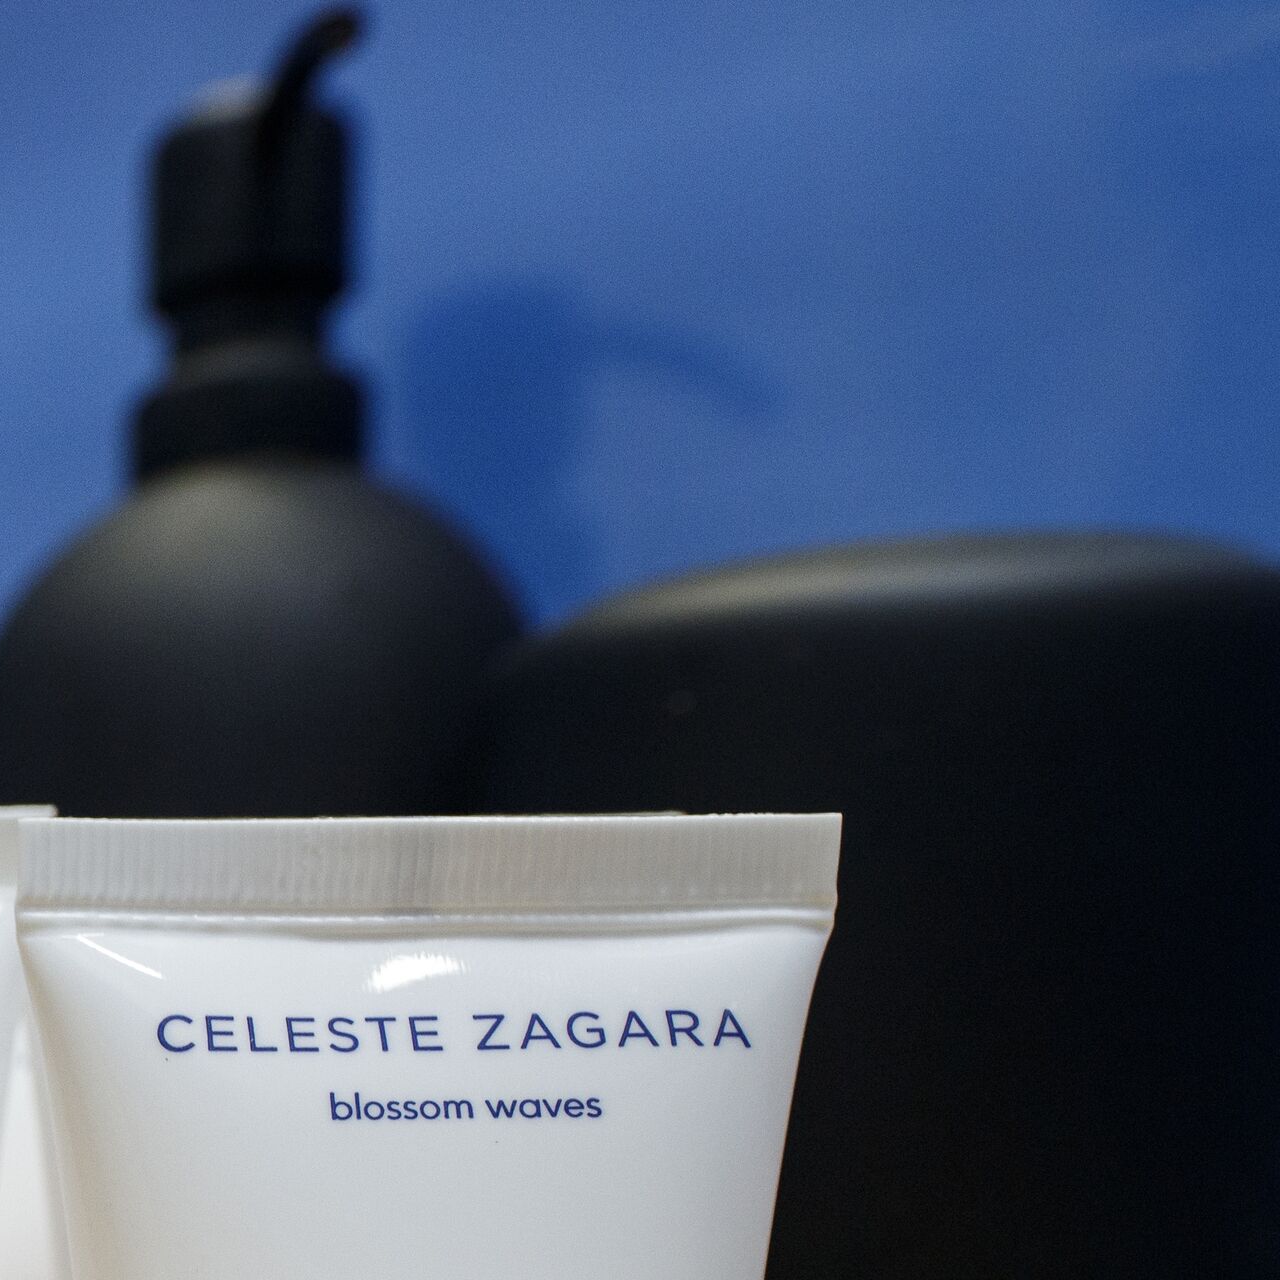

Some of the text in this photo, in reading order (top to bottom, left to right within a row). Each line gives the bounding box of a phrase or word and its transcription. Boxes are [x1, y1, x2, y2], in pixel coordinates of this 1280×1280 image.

[154, 1008, 753, 1054] CELESTE ZAGARA
[328, 1091, 605, 1122] blossom waves
